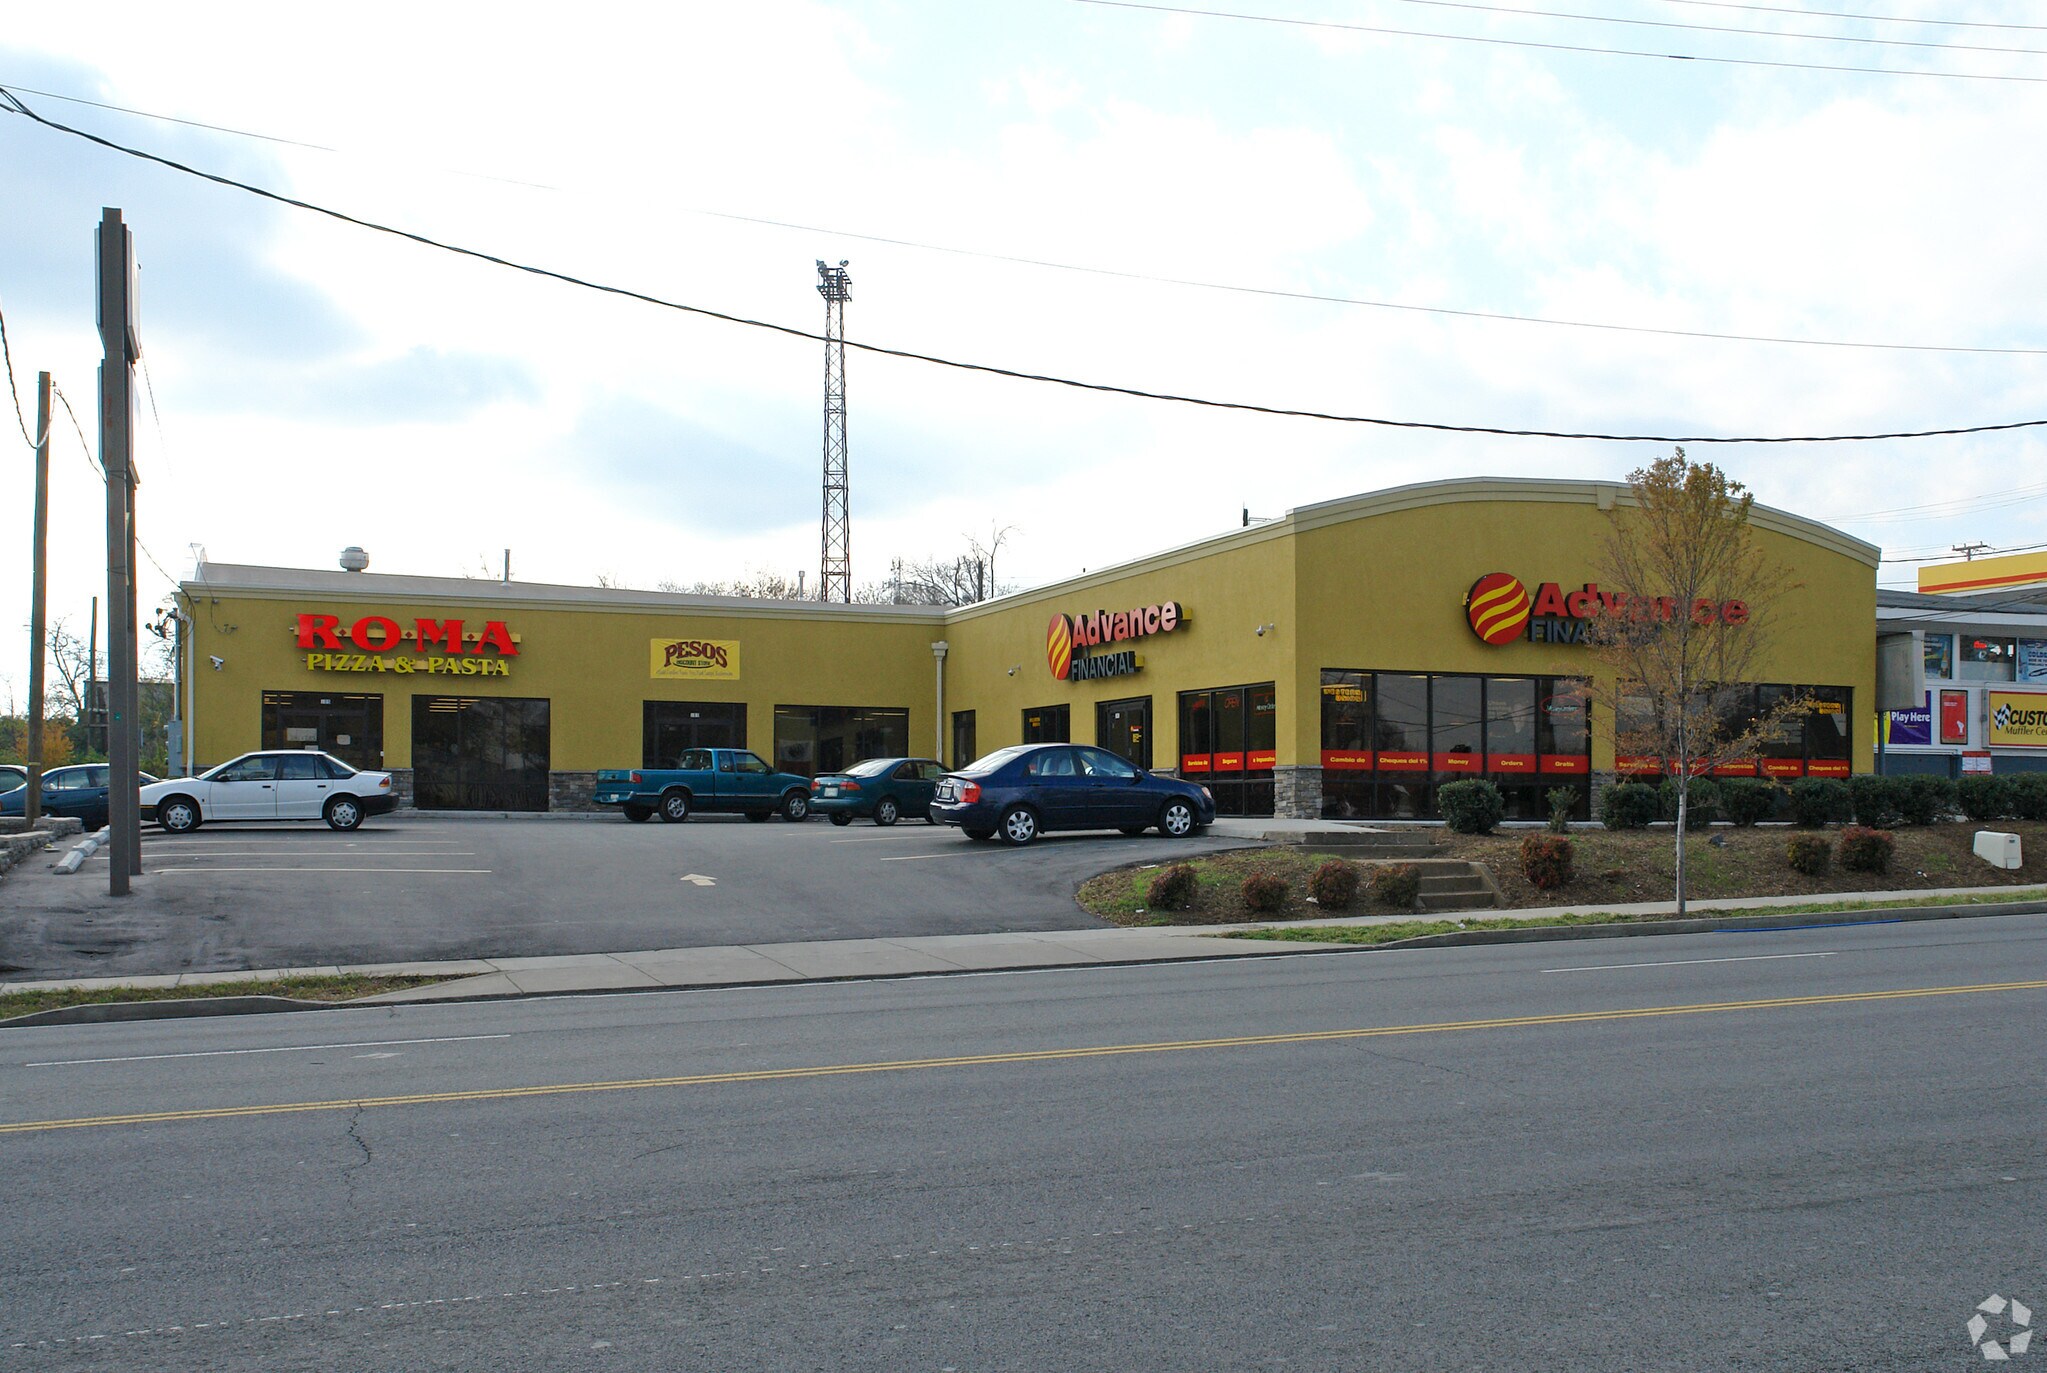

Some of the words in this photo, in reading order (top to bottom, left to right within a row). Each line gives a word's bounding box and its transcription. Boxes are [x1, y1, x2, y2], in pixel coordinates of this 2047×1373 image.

[1072, 600, 1180, 649] Advance
[306, 653, 387, 673] PIZZA
[393, 656, 416, 674] &
[427, 656, 510, 676] PASTA
[663, 640, 728, 668] PESOS
[1071, 651, 1135, 681] FINANCIAL
[1891, 711, 1910, 723] Play
[1910, 712, 1931, 722] Here
[2005, 726, 2034, 736] Muffler
[1447, 758, 1469, 766] Money
